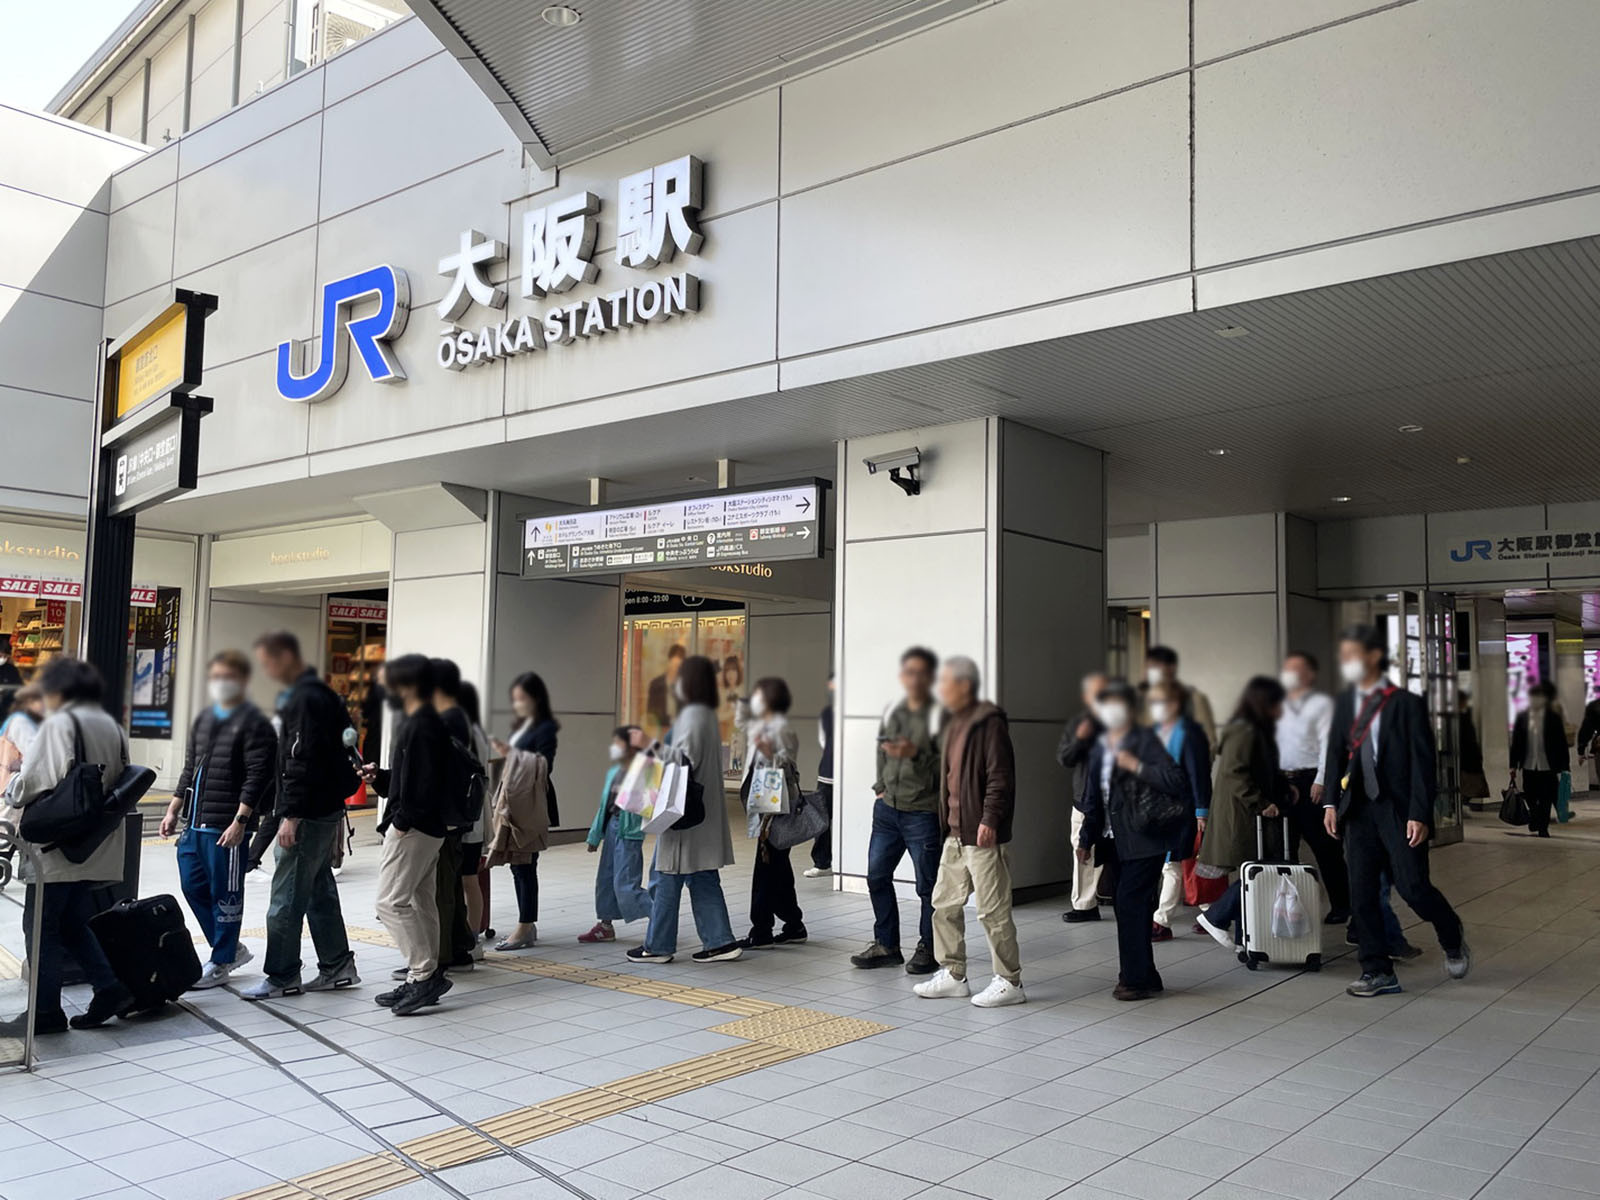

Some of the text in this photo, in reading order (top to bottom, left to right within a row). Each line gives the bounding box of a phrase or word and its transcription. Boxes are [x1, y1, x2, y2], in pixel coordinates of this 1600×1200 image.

[437, 154, 698, 321] 大阪駅
[437, 272, 690, 369] ŌSAKA STATION
[276, 263, 399, 402] JR
[0, 541, 79, 561] kstudio
[1450, 540, 1492, 562] JR
[1, 580, 39, 592] SALE
[43, 583, 80, 595] SALE
[330, 607, 357, 617] SALE
[359, 608, 386, 618] SALE
